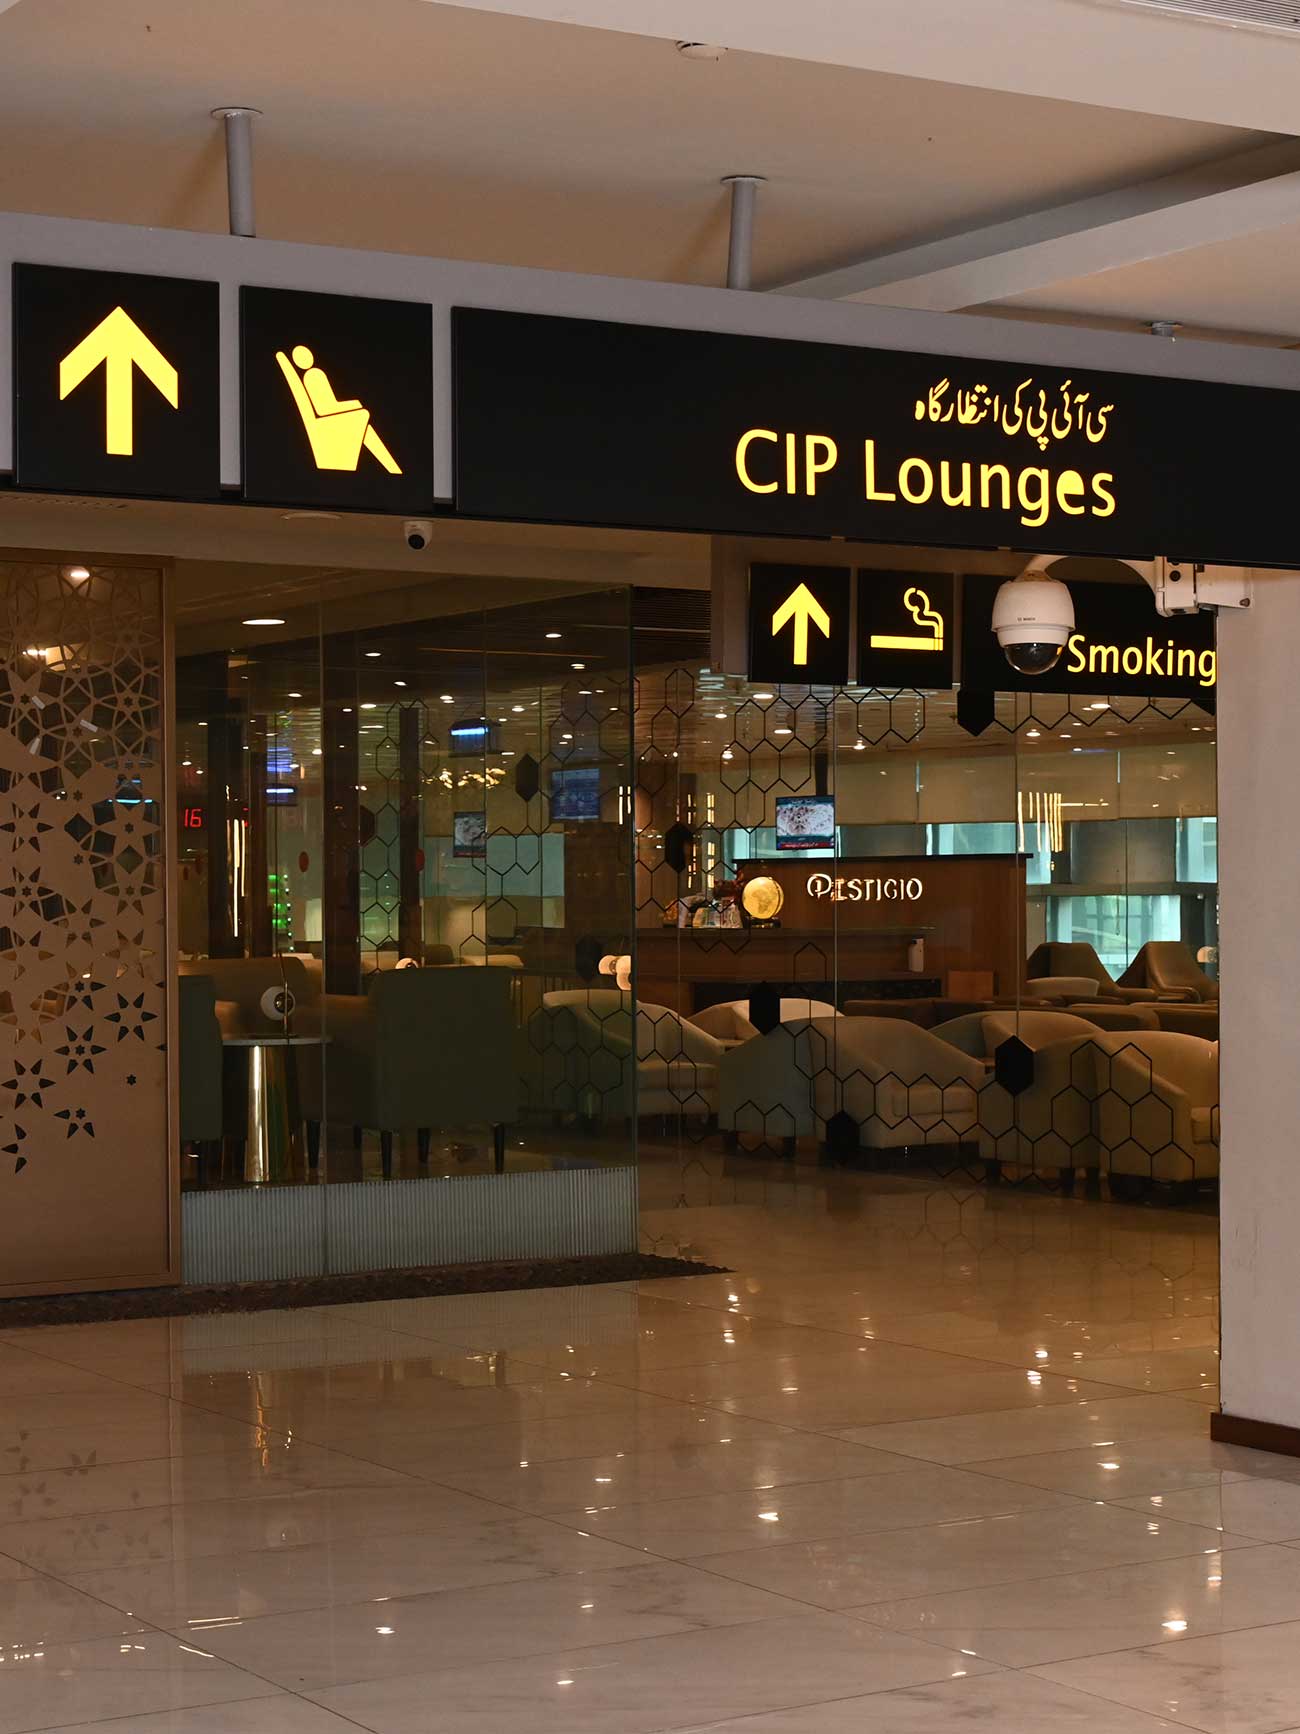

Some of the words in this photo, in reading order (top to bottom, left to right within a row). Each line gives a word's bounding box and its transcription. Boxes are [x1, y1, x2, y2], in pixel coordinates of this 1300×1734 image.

[735, 428, 838, 496] CIP
[865, 439, 1117, 527] Lounges
[1067, 634, 1217, 687] Smoking
[184, 808, 202, 828] 16
